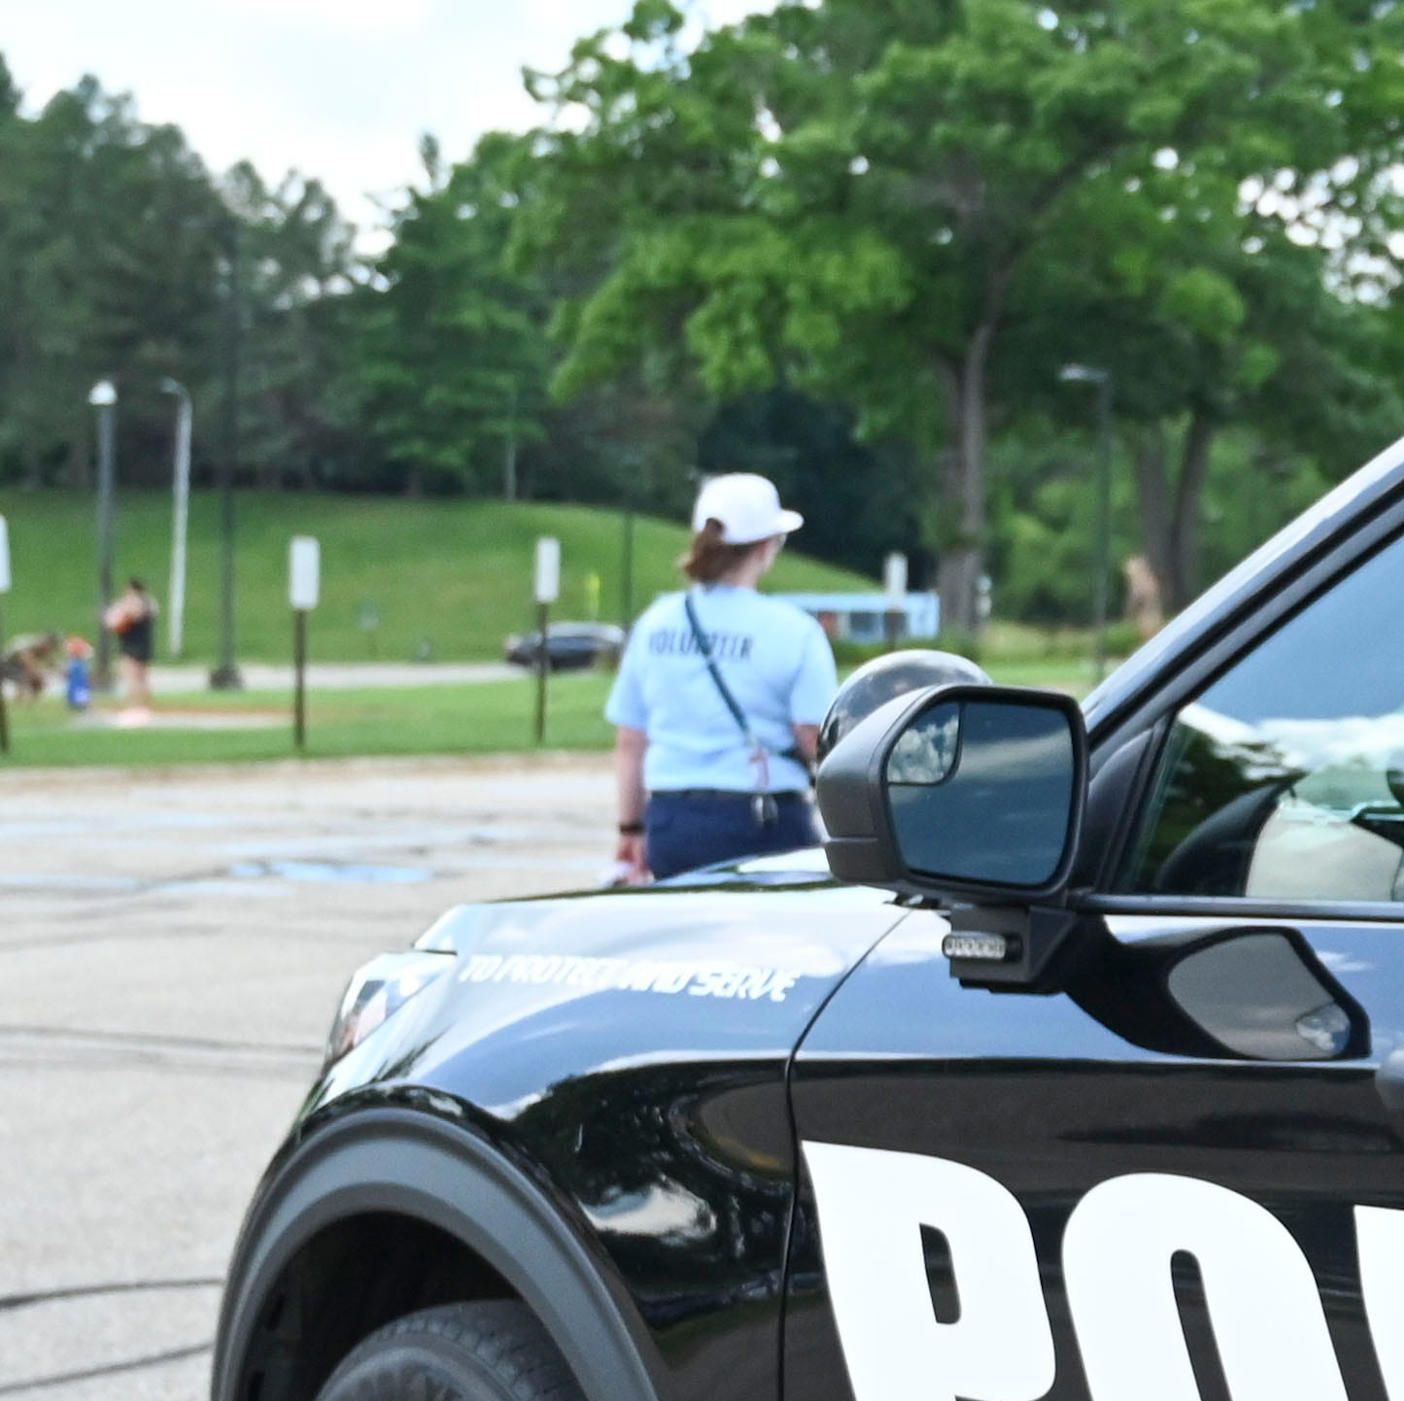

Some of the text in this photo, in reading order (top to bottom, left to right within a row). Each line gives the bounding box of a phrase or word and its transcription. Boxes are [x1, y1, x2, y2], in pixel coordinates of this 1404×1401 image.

[460, 955, 797, 1001] TO PROTECT AND SERVE
